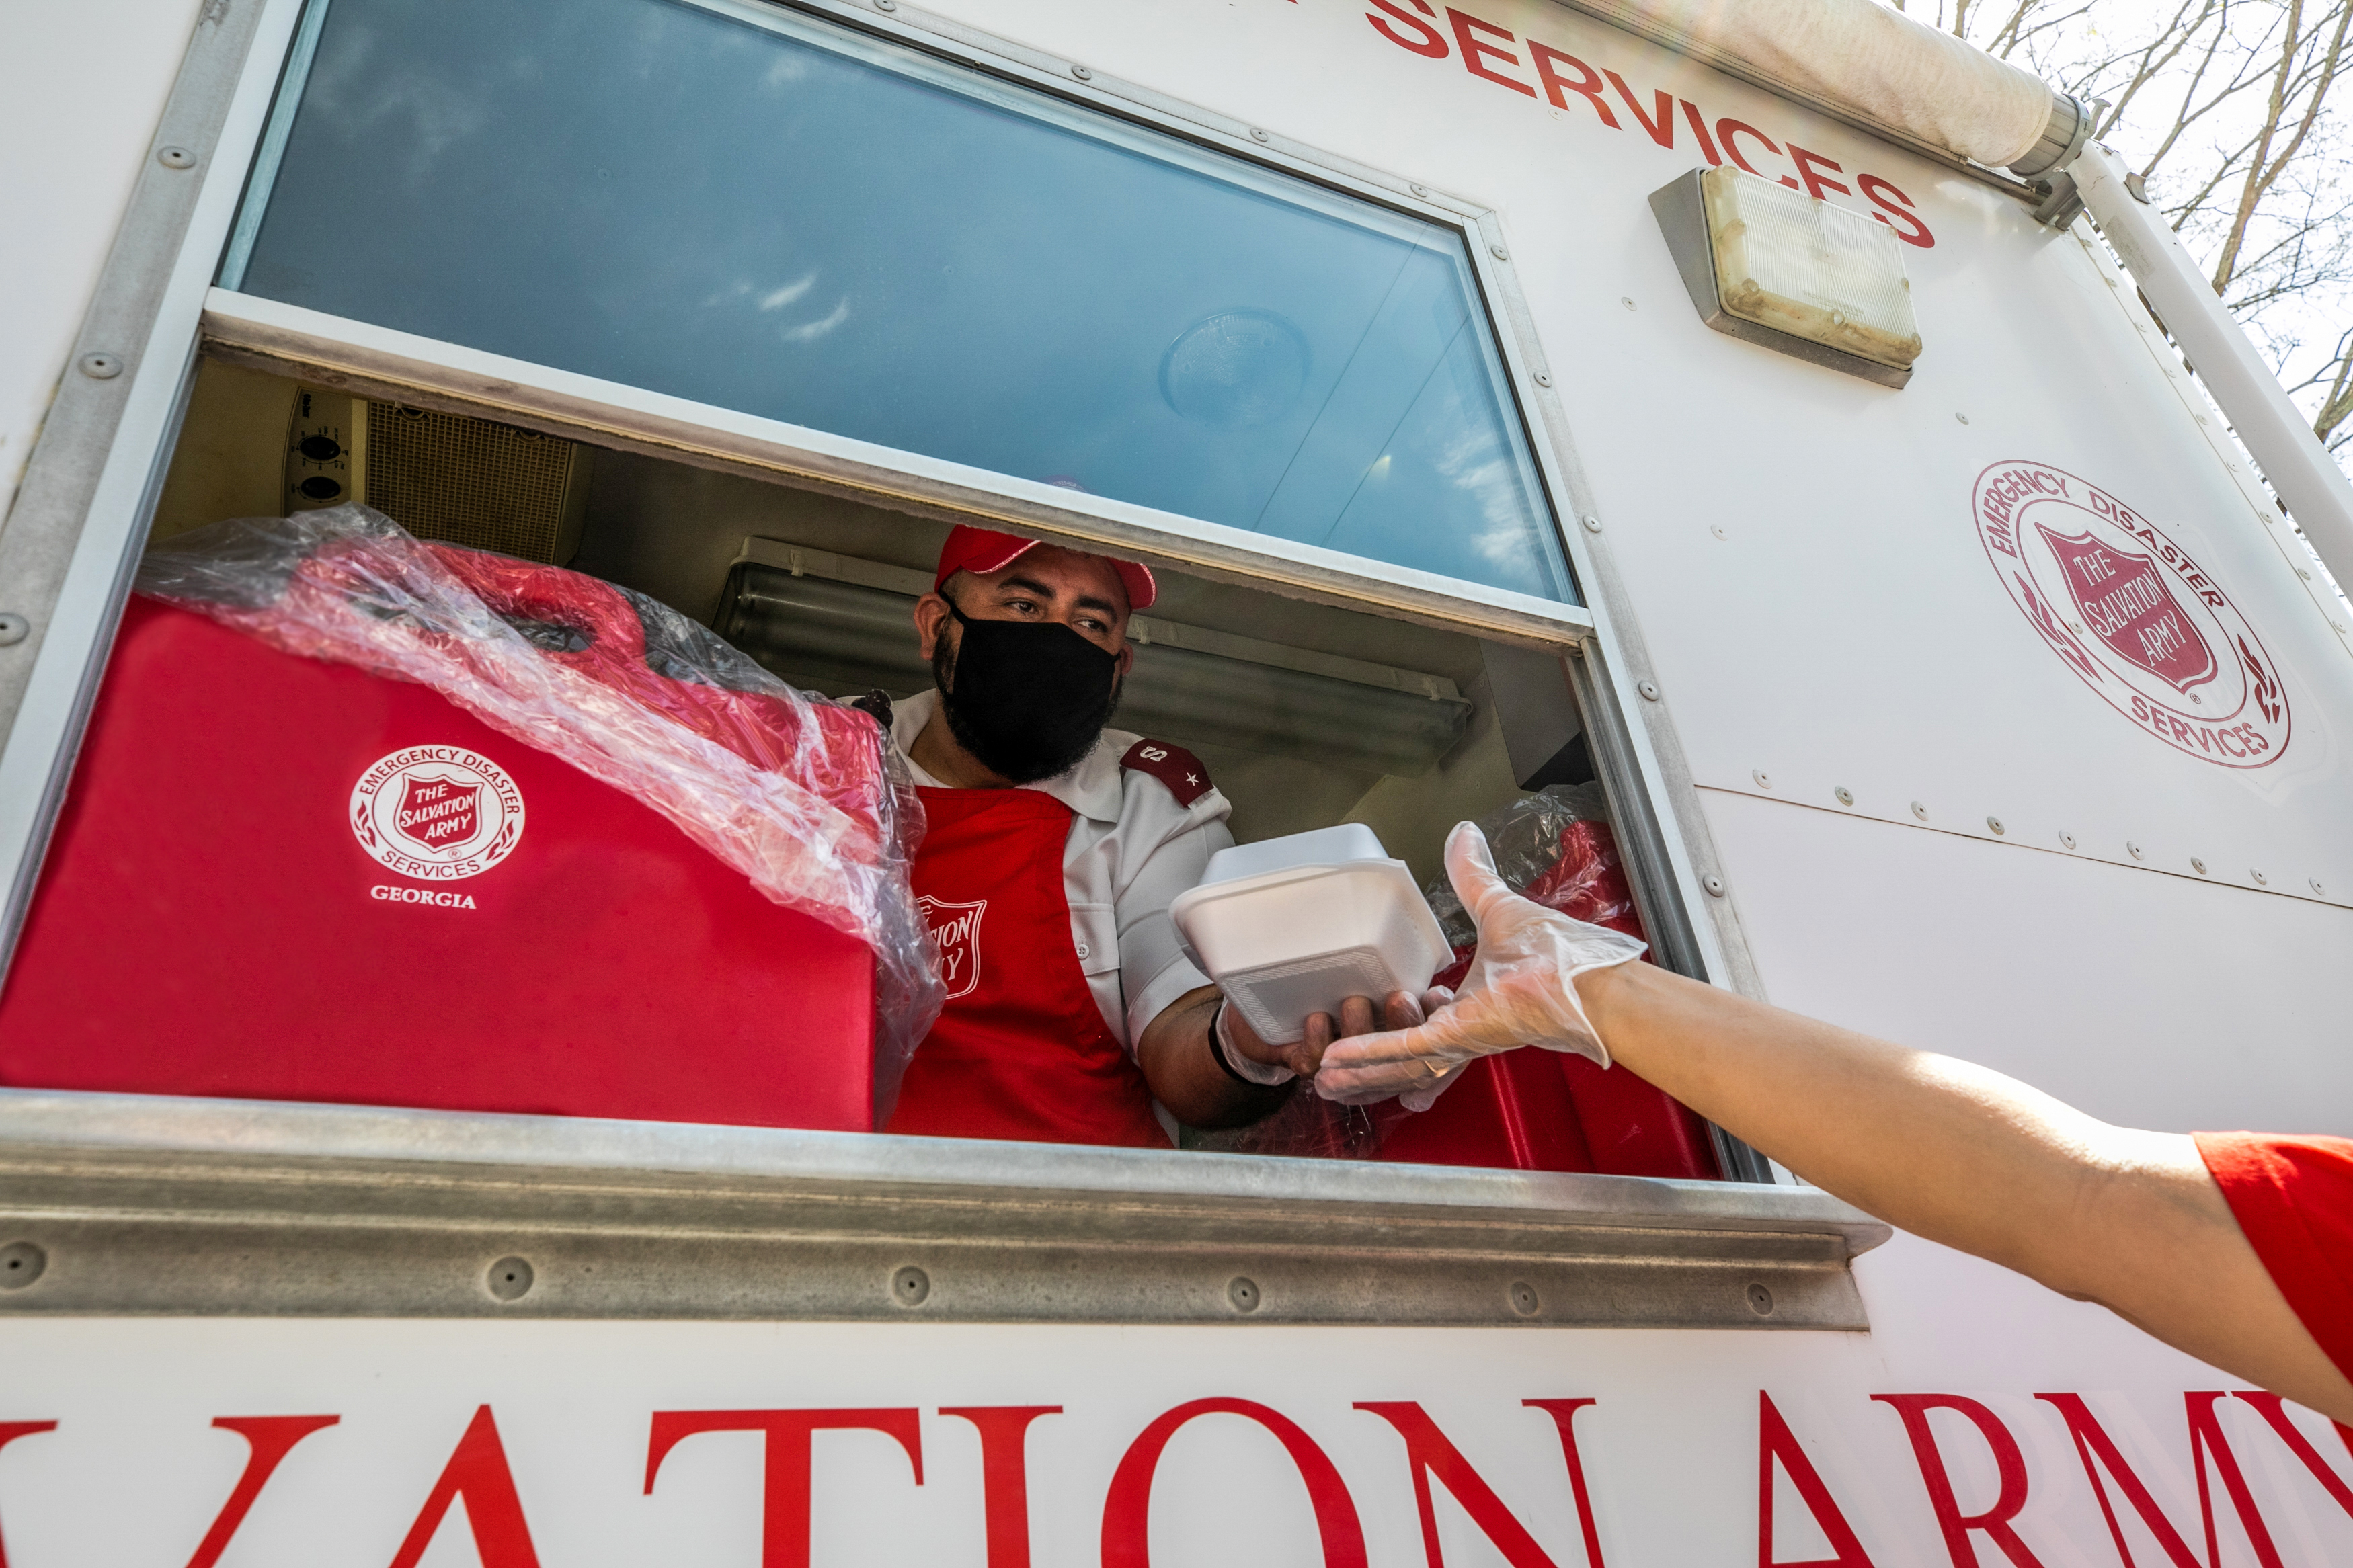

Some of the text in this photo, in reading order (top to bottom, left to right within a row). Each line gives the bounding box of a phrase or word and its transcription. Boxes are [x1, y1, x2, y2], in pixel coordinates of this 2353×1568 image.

[1365, 0, 1935, 248] SERVICES
[1983, 470, 2224, 607] EMERGENCY DISASTER
[2073, 548, 2116, 587] THE
[2084, 567, 2167, 637] SALVATION
[2137, 609, 2187, 667] ARMY
[2130, 695, 2269, 758] SERVICES
[359, 748, 520, 814] EMERGENCY DISASTER
[415, 784, 449, 804] THE
[400, 792, 475, 828] SALVATION
[424, 813, 472, 841] ARMY
[381, 850, 481, 878] SERVICES
[370, 884, 477, 909] GEORGIA
